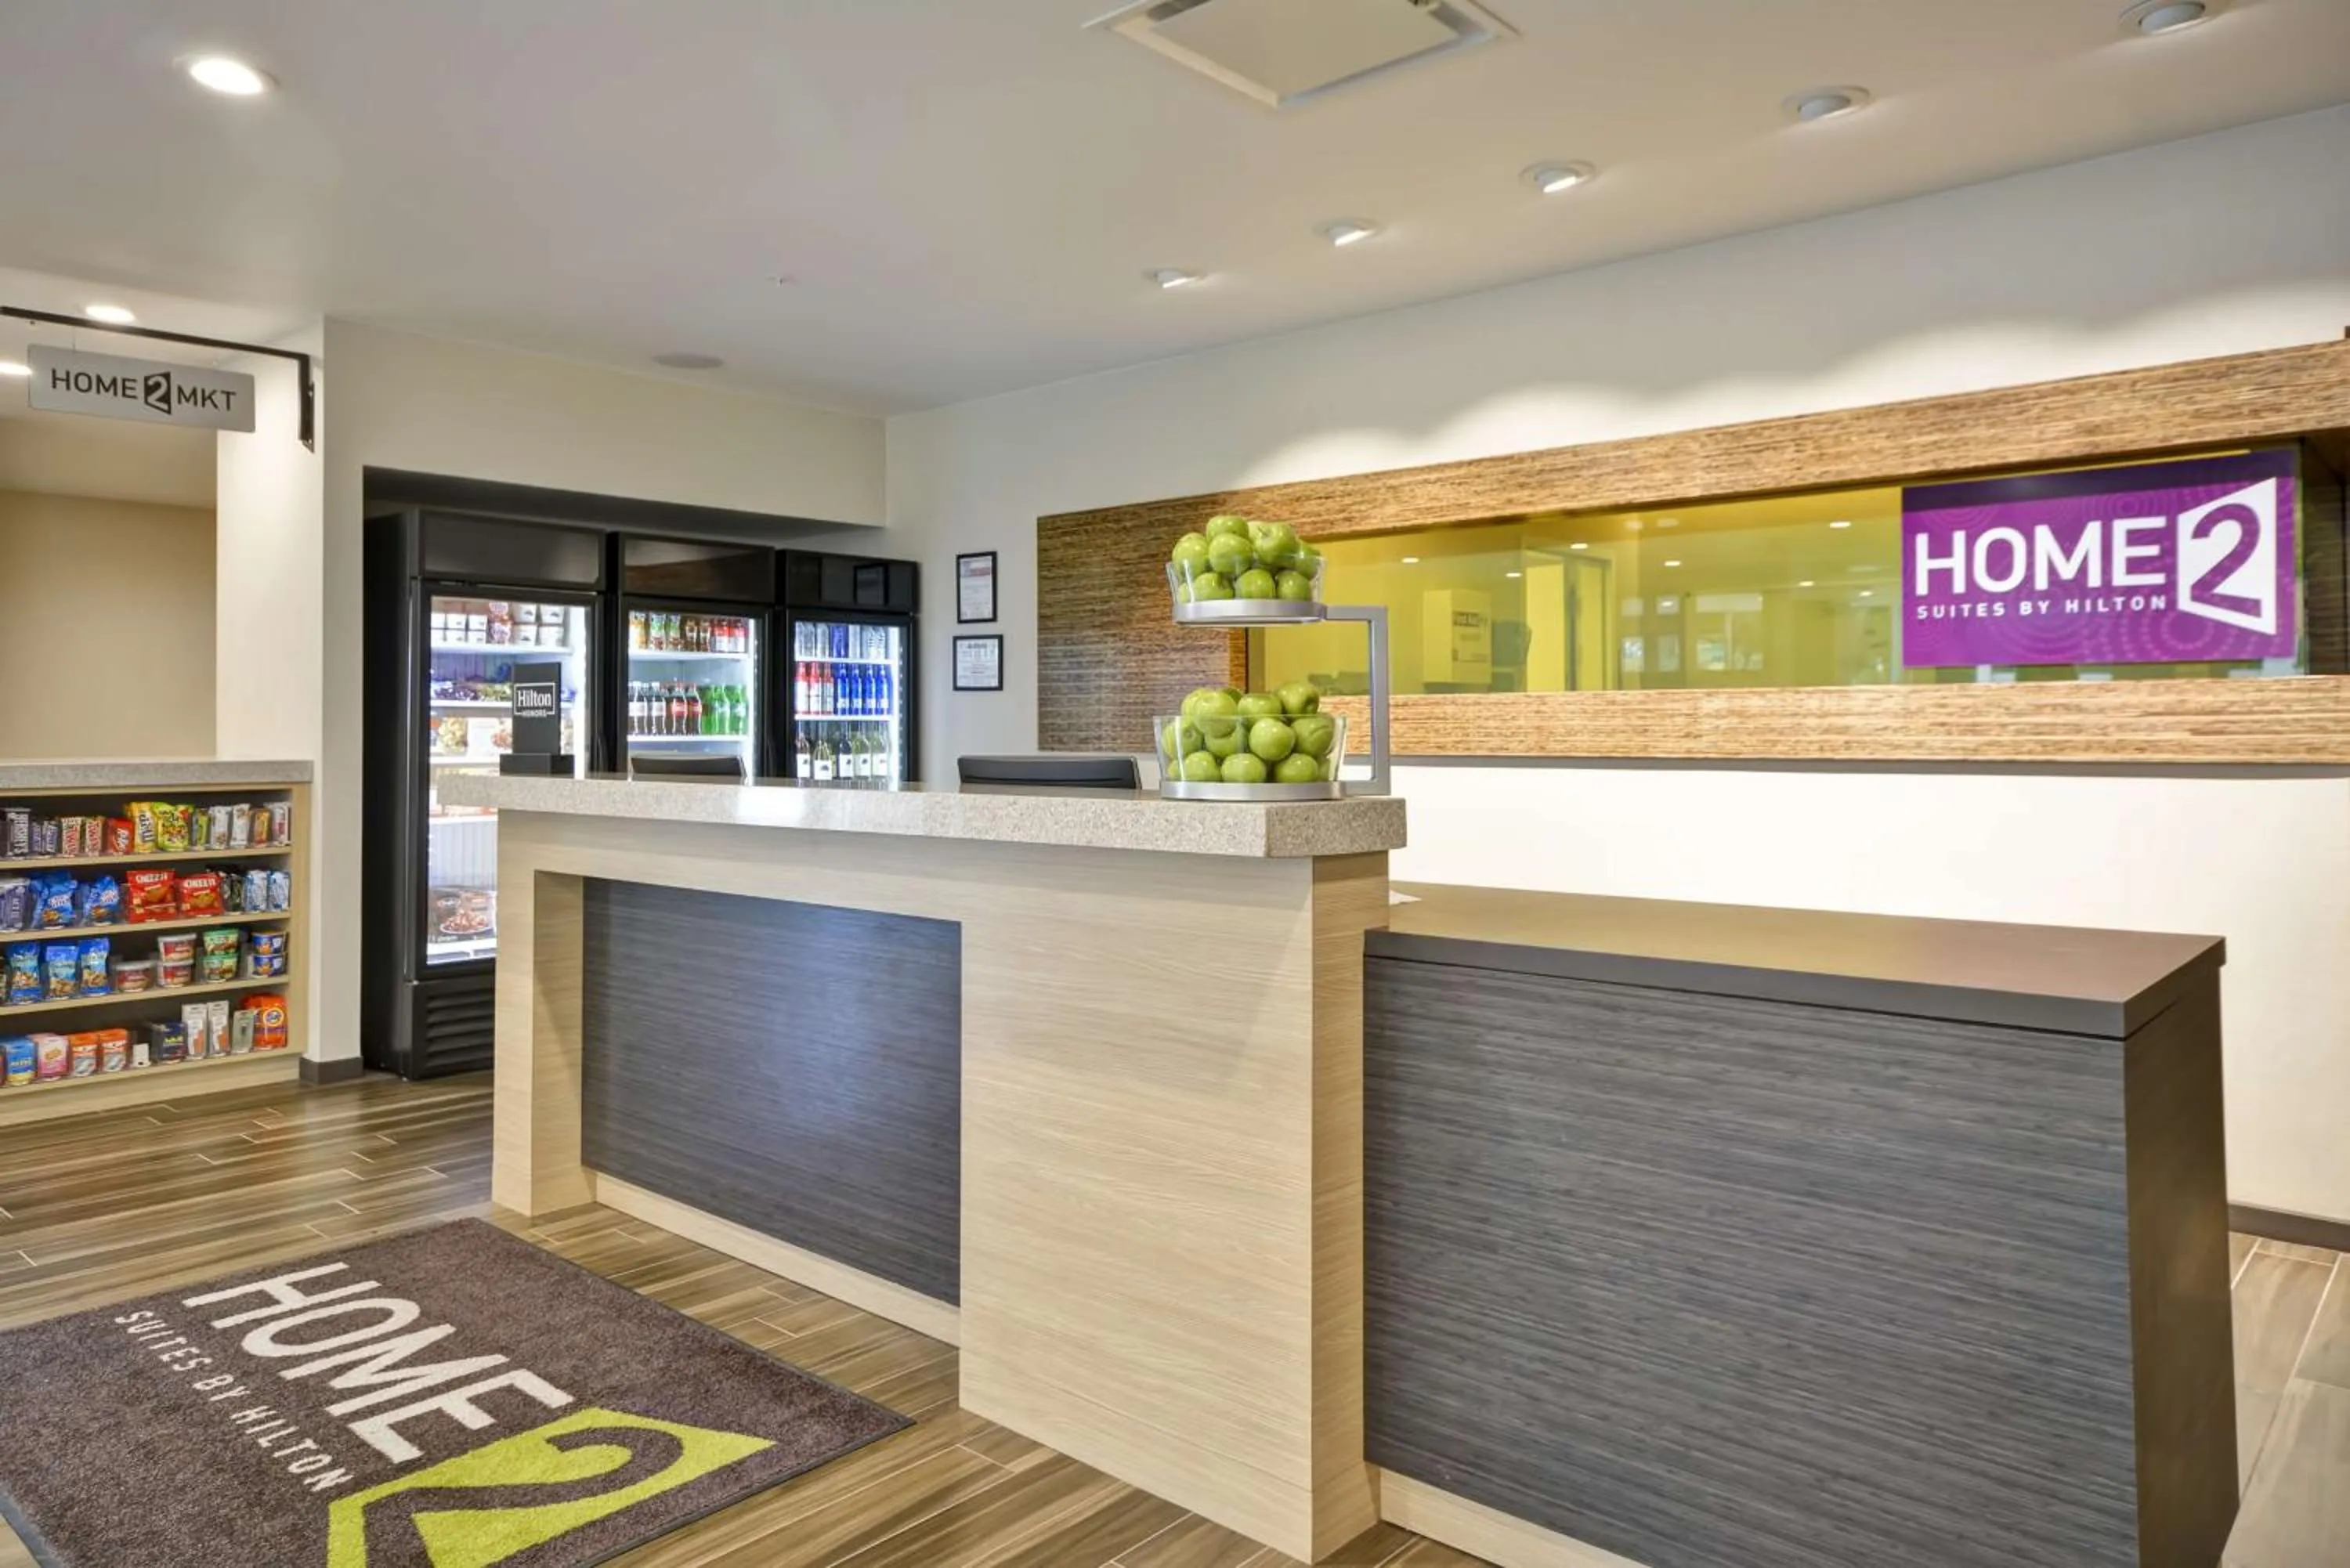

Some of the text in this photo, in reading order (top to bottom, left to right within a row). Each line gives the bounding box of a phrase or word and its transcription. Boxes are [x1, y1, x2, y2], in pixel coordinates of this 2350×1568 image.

[52, 368, 139, 400] HOME
[177, 385, 237, 411] MKT
[1914, 515, 2167, 596] HOME
[1917, 595, 2167, 620] SUITES BY HILTON
[518, 689, 552, 706] Hilton
[182, 1262, 575, 1464] HOME
[114, 1310, 355, 1492] SUITES BY HILTON
